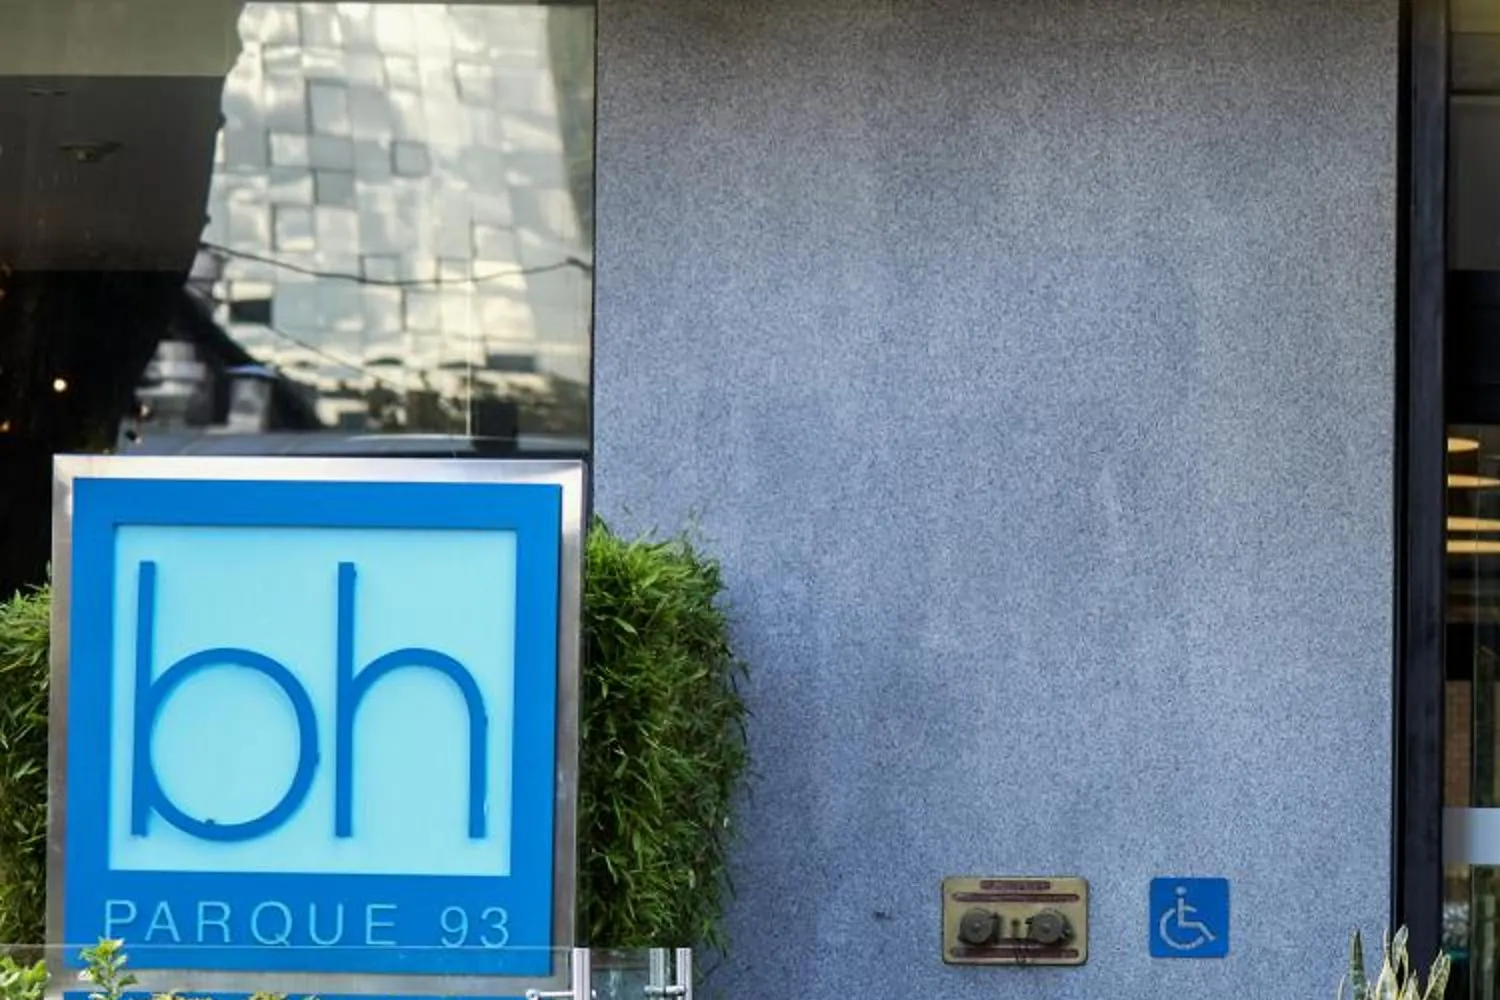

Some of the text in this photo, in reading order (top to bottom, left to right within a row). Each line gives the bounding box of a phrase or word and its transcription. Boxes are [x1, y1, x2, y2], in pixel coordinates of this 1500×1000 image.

[131, 561, 488, 843] bh
[104, 899, 510, 949] PARQUE 93
